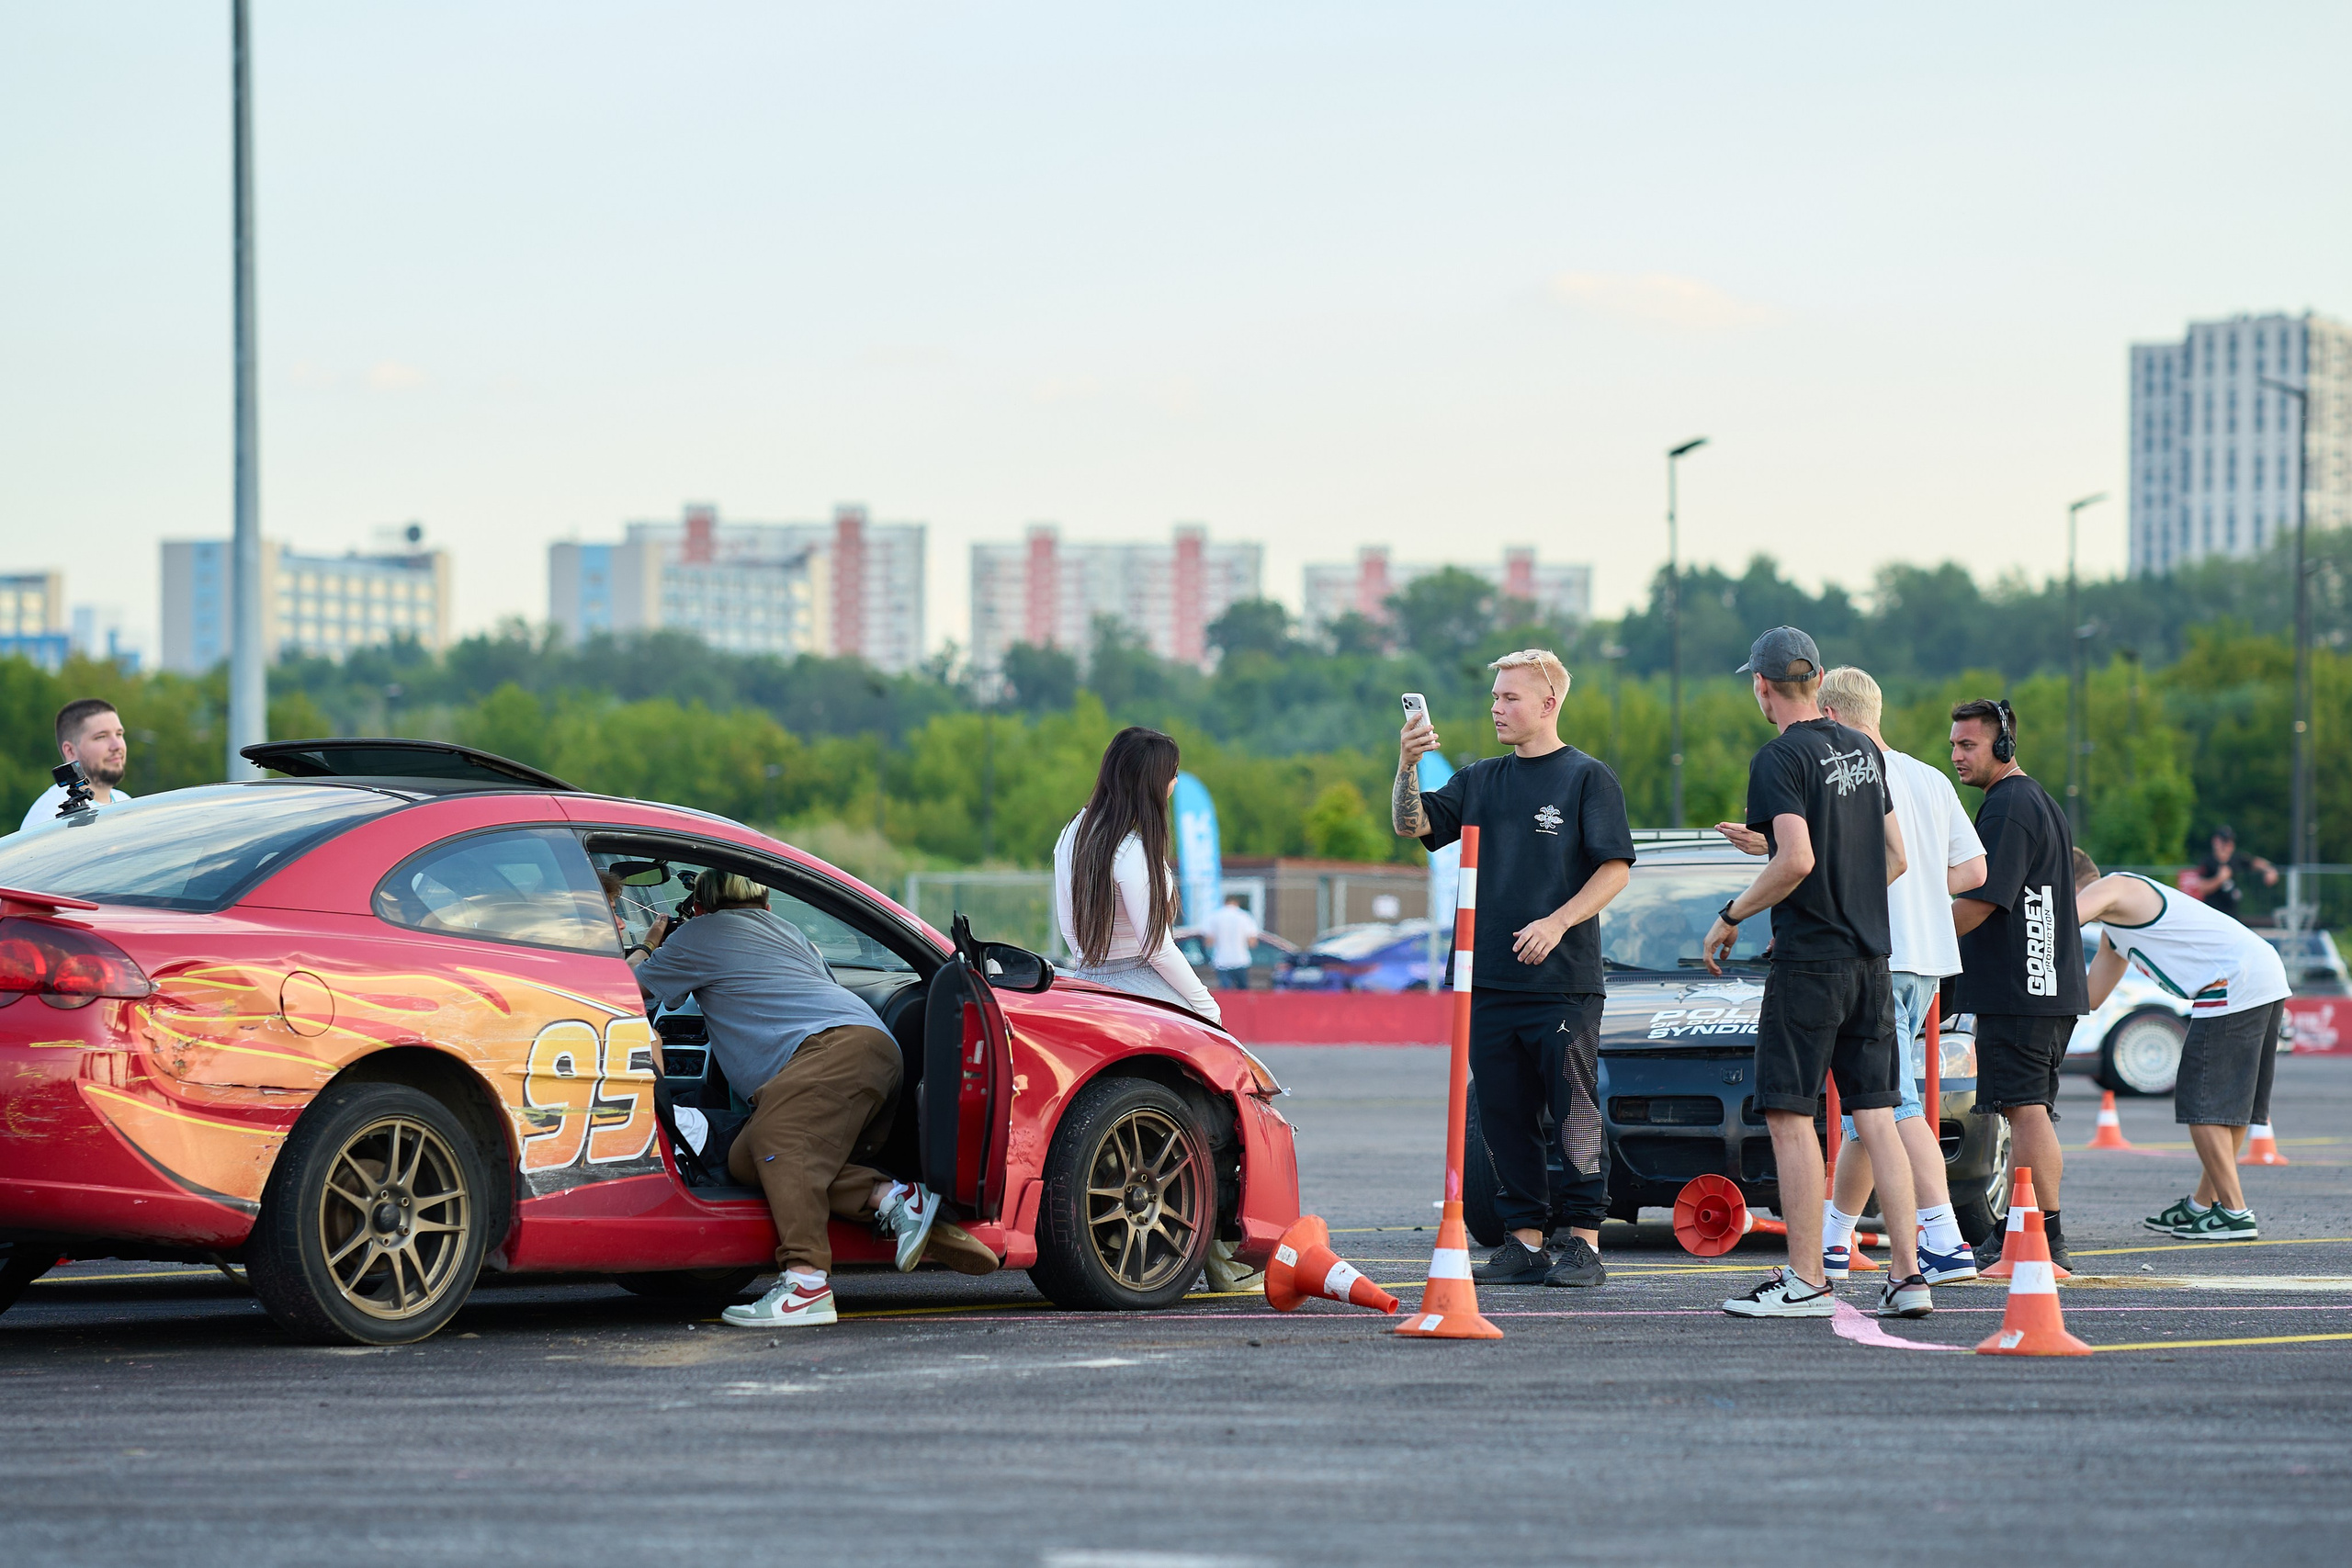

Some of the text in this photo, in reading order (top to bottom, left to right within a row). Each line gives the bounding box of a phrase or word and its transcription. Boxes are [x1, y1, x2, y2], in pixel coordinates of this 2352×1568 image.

[2024, 886, 2045, 997] GORDEY
[2044, 909, 2053, 973] PRODUCTION
[1650, 1021, 1679, 1029] OF
[519, 1016, 657, 1174] 95
